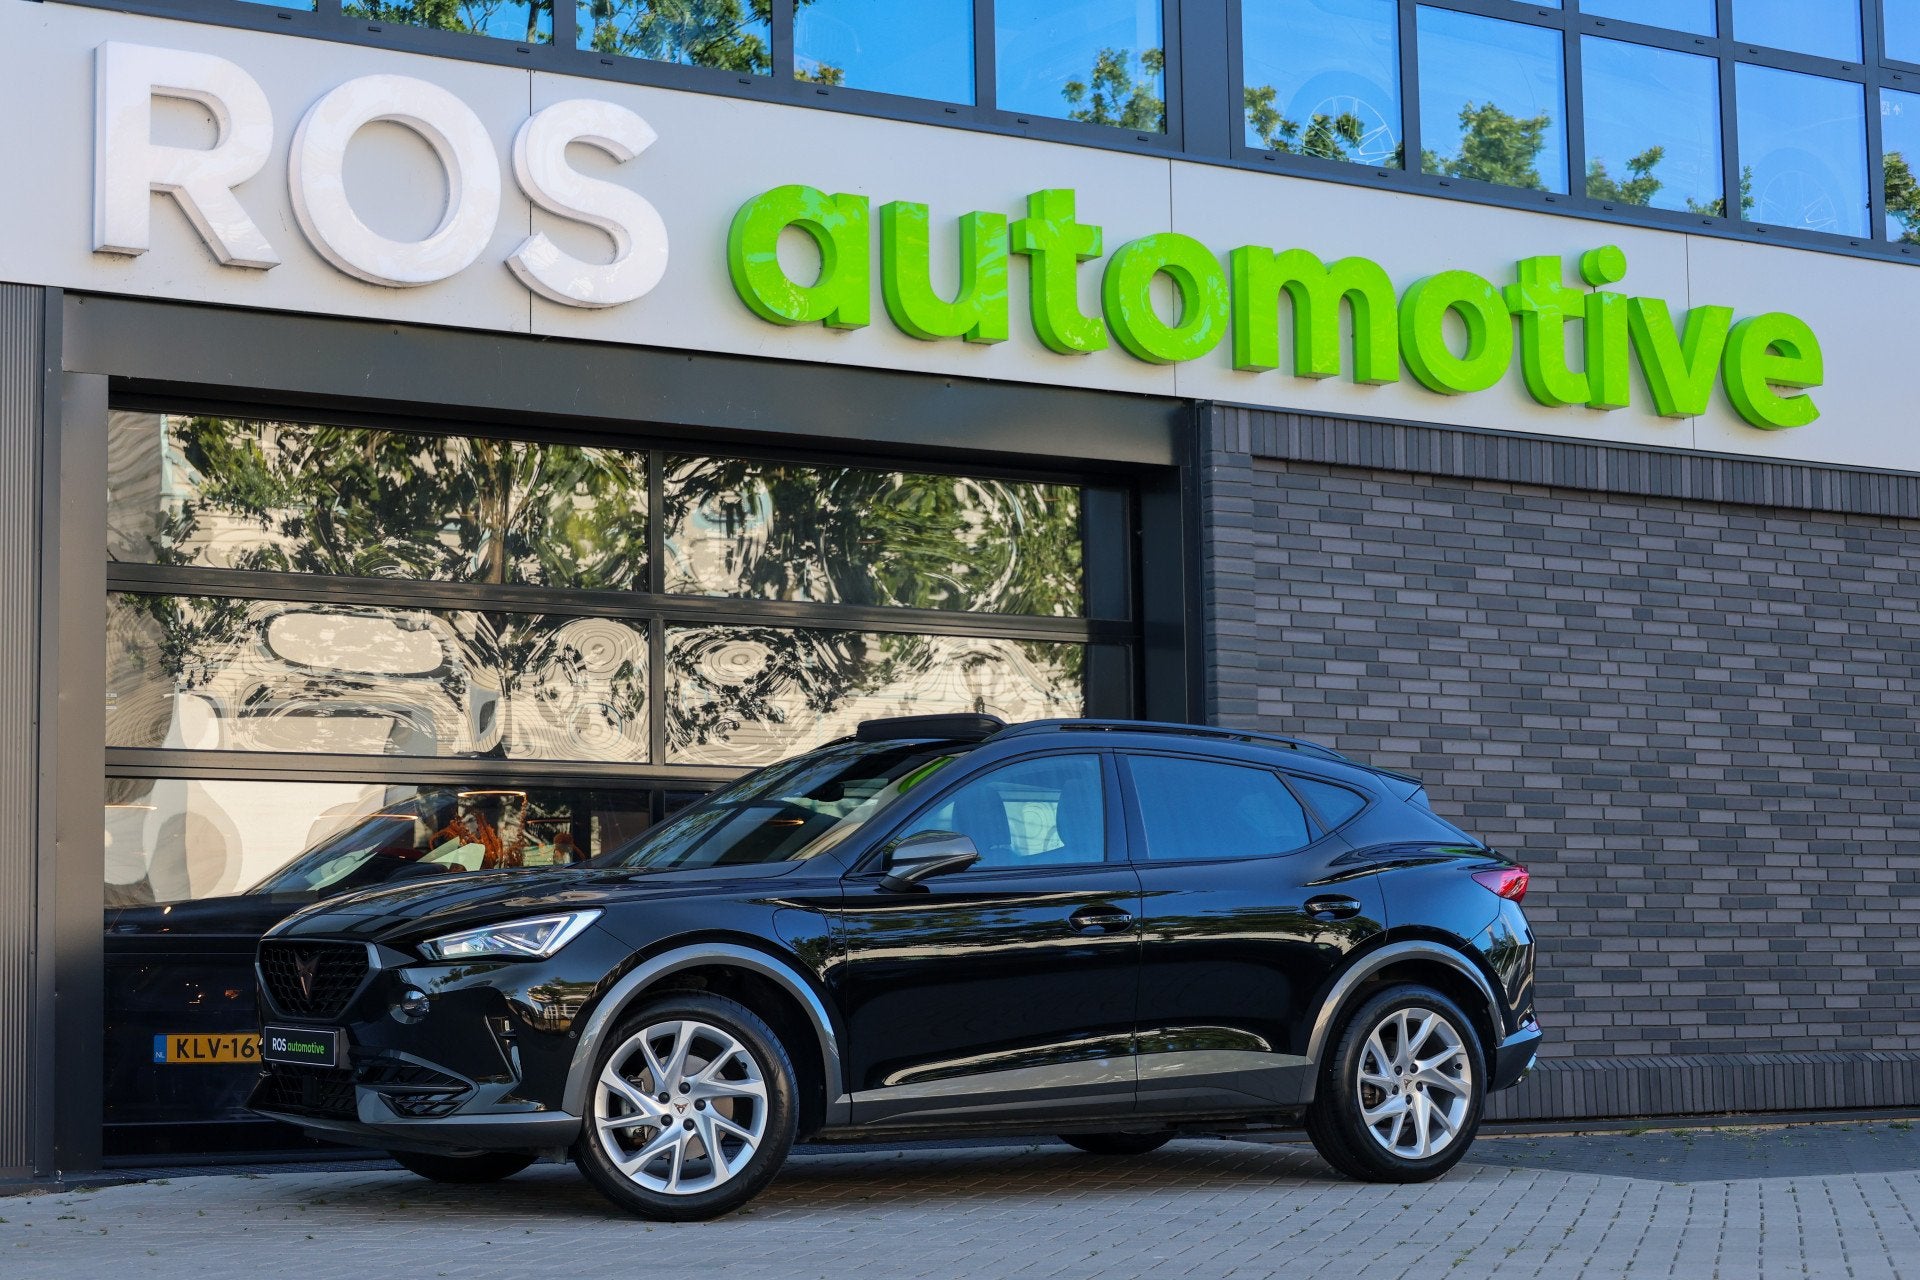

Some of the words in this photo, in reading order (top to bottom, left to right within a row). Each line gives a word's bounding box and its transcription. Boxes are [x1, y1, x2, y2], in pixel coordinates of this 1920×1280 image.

[93, 40, 670, 309] ROS
[729, 184, 1823, 430] automotive
[272, 1038, 286, 1051] ROS
[287, 1041, 325, 1054] automotive
